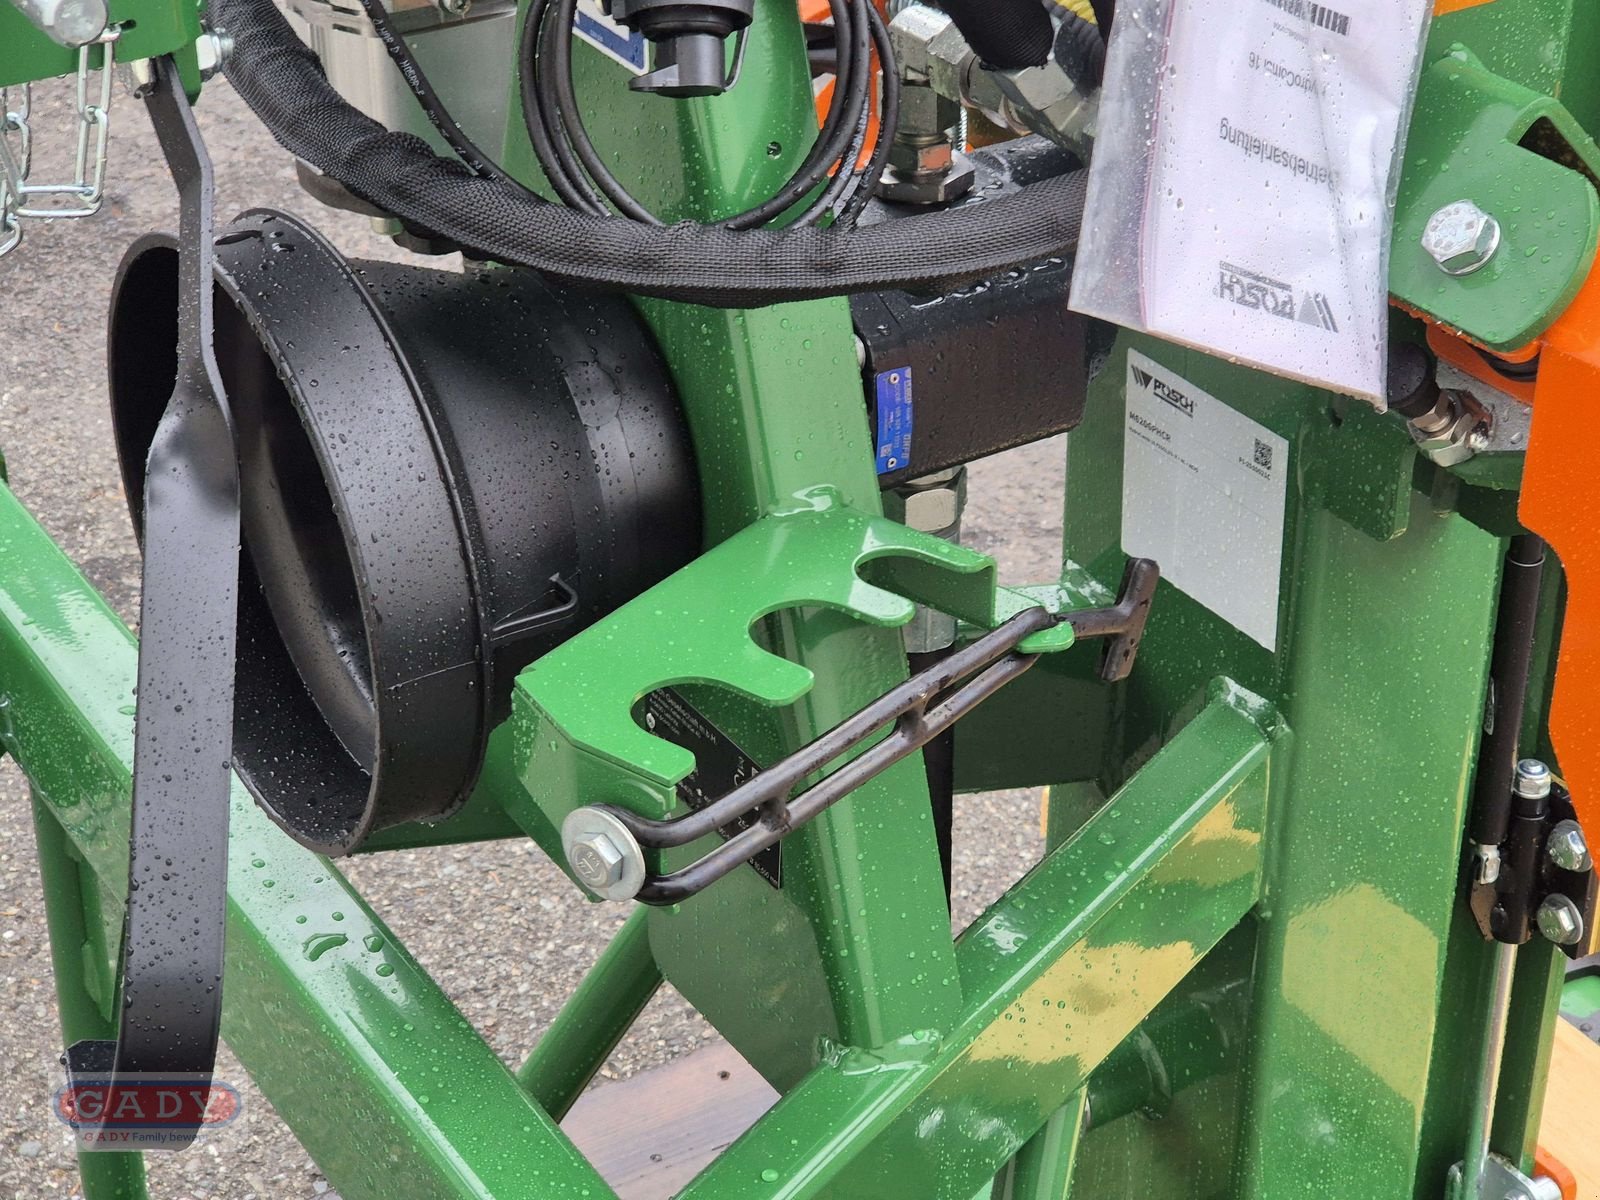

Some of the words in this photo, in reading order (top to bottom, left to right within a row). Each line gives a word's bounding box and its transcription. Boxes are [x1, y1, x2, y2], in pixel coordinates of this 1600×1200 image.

[1247, 51, 1261, 74] 16
[1218, 272, 1296, 320] POSCH
[1153, 378, 1195, 413] POSCH
